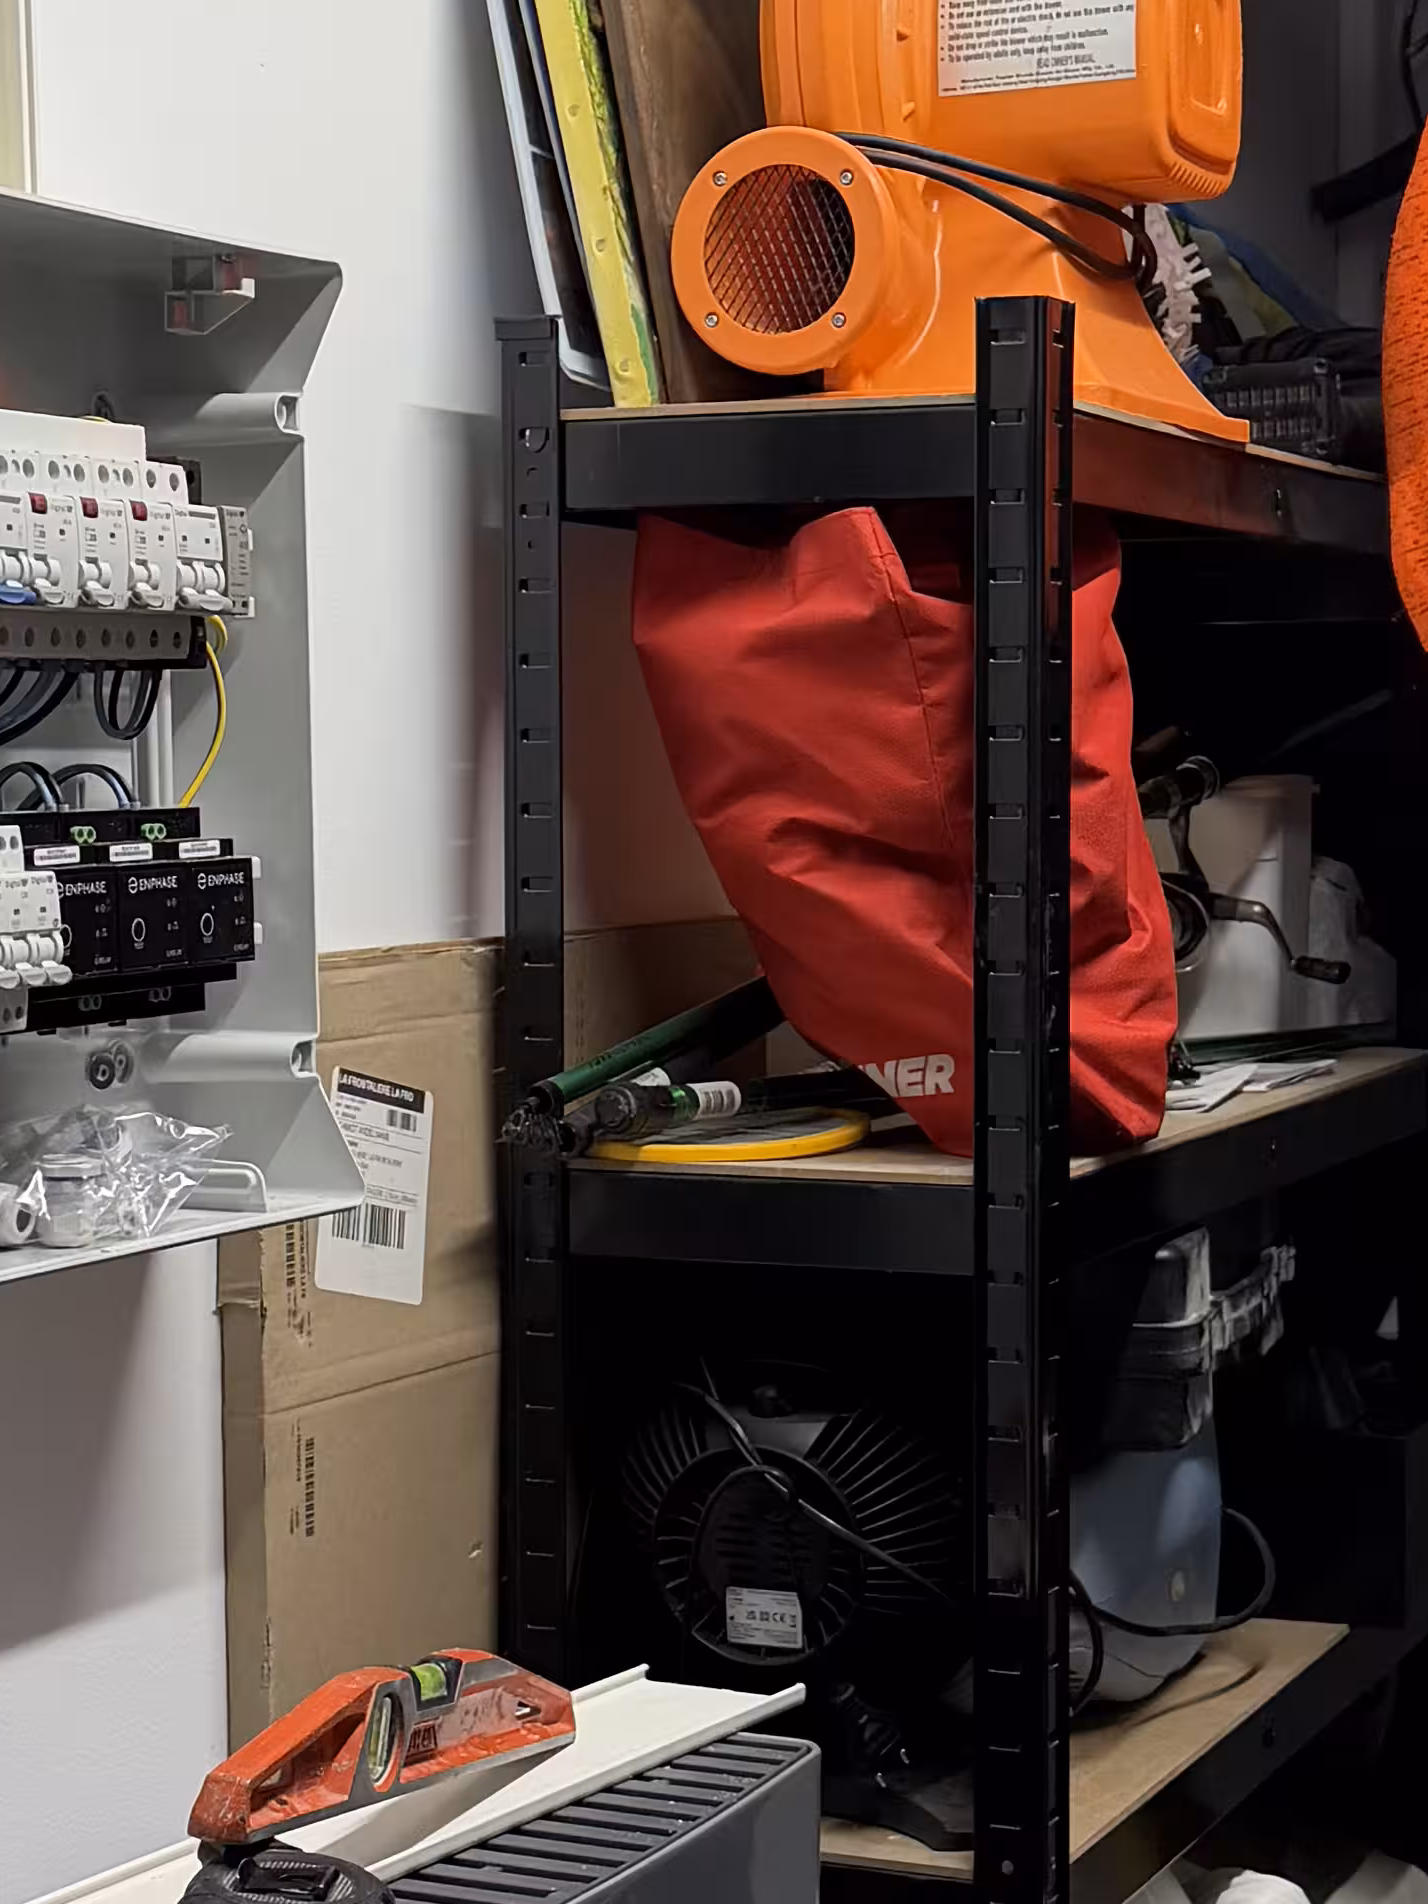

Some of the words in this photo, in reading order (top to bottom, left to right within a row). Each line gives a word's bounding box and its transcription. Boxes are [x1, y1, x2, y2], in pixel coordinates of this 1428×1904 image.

[139, 875, 178, 891] ENPHASE
[207, 872, 245, 887] ENPHASE
[65, 881, 107, 896] ENPHASE
